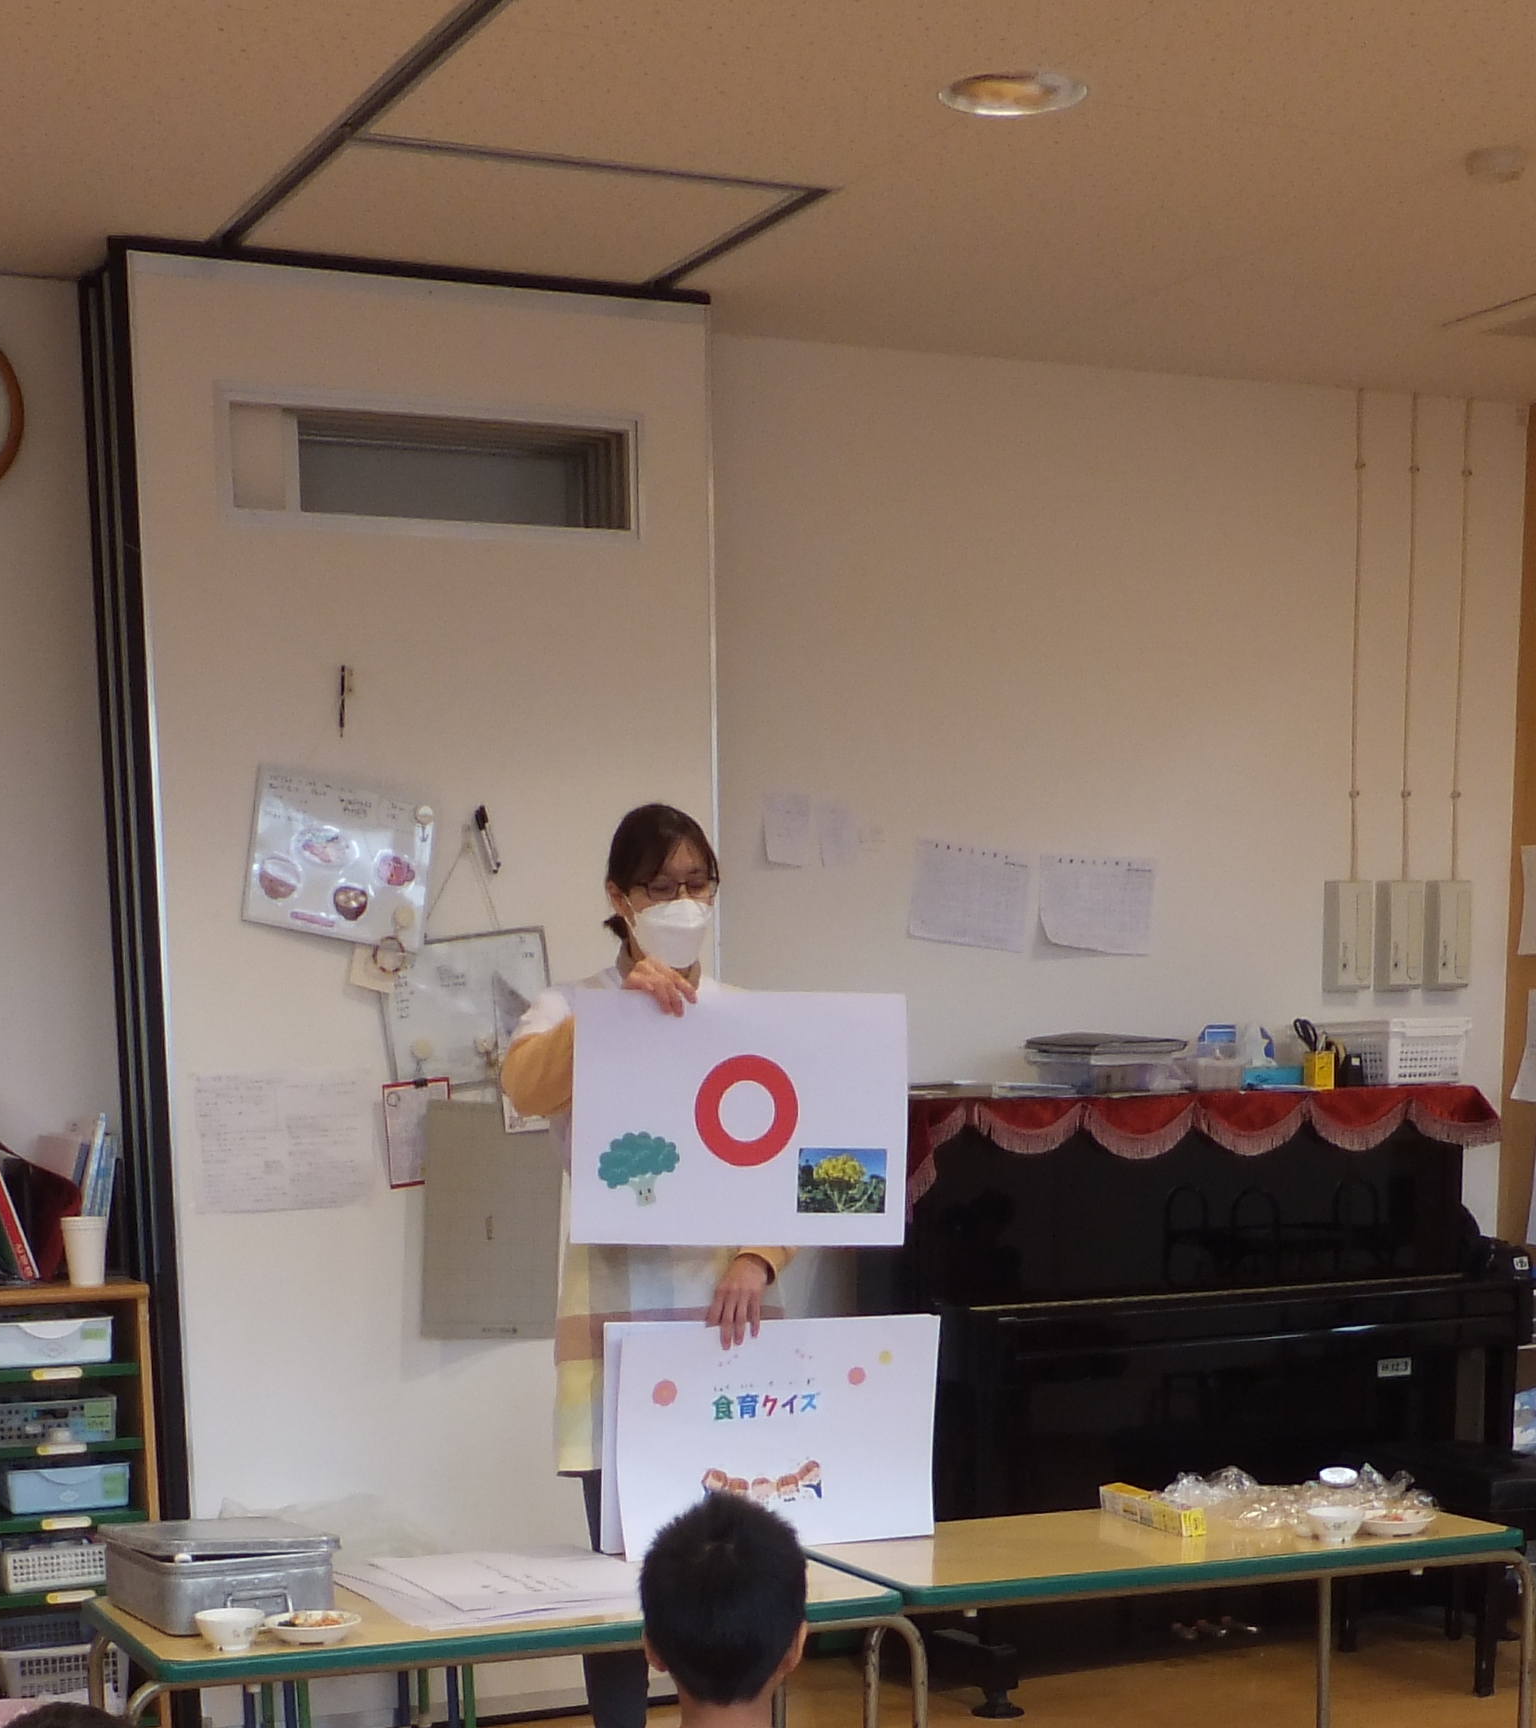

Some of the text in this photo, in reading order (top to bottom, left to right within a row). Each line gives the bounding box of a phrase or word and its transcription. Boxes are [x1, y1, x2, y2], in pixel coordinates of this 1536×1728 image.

[712, 1391, 821, 1421] 食育クイズ
